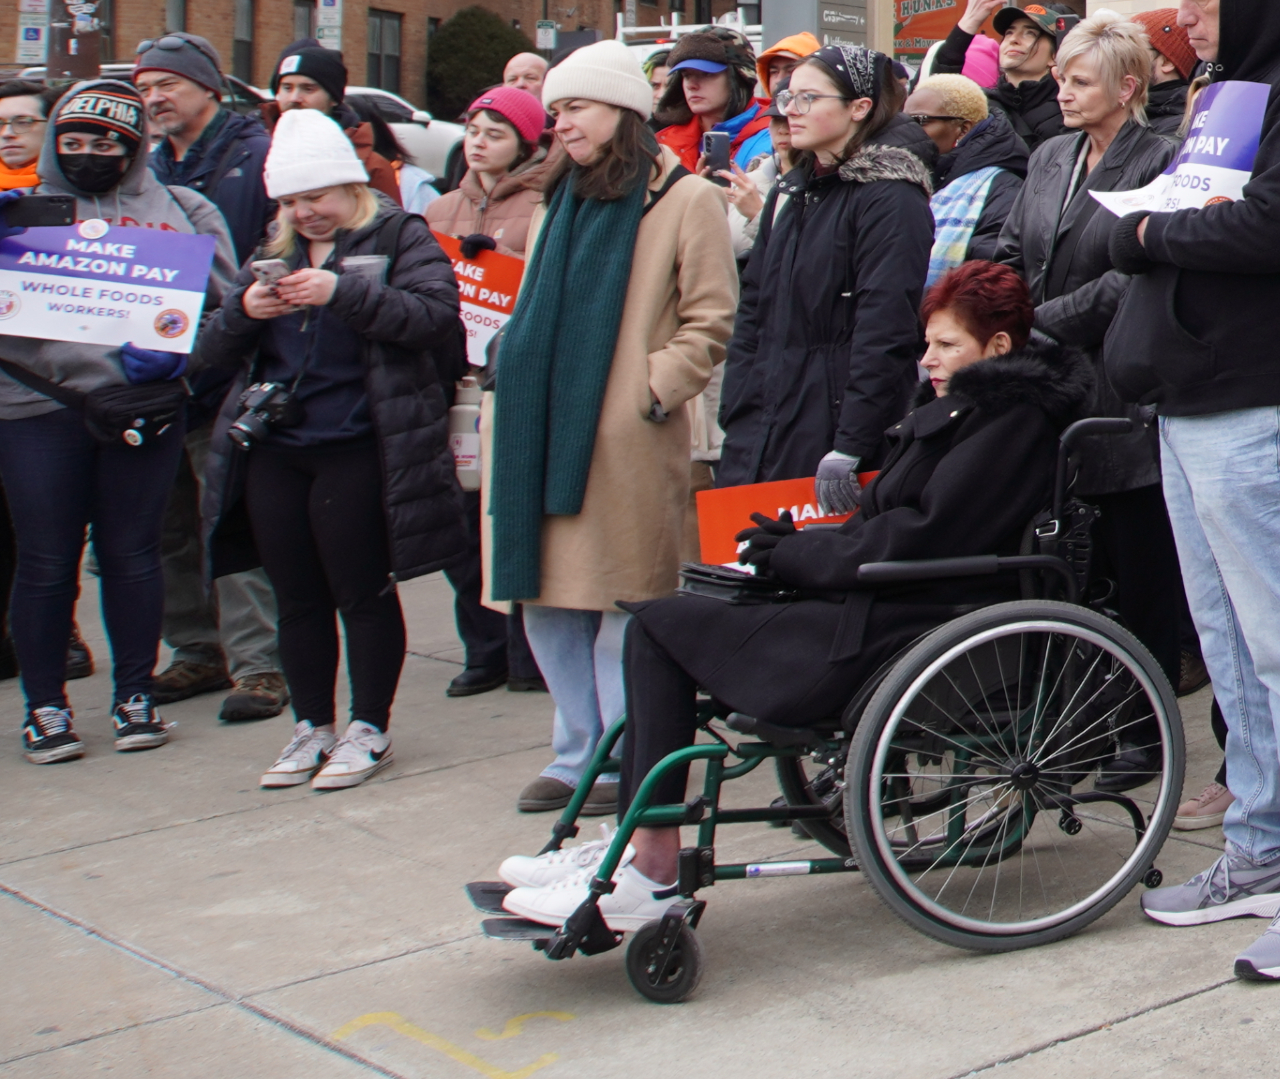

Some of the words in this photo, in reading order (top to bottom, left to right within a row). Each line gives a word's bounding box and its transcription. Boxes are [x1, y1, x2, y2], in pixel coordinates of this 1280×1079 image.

[1195, 136, 1229, 156] PAY
[1173, 174, 1211, 192] FOODS
[65, 239, 137, 258] MAKE
[17, 251, 127, 276] AMAZON
[131, 264, 180, 282] PAY
[452, 259, 485, 281] AKE
[20, 280, 94, 298] WHOLE
[98, 290, 164, 306] FOODS
[478, 287, 512, 307] PAY
[46, 302, 131, 319] WORKERS!
